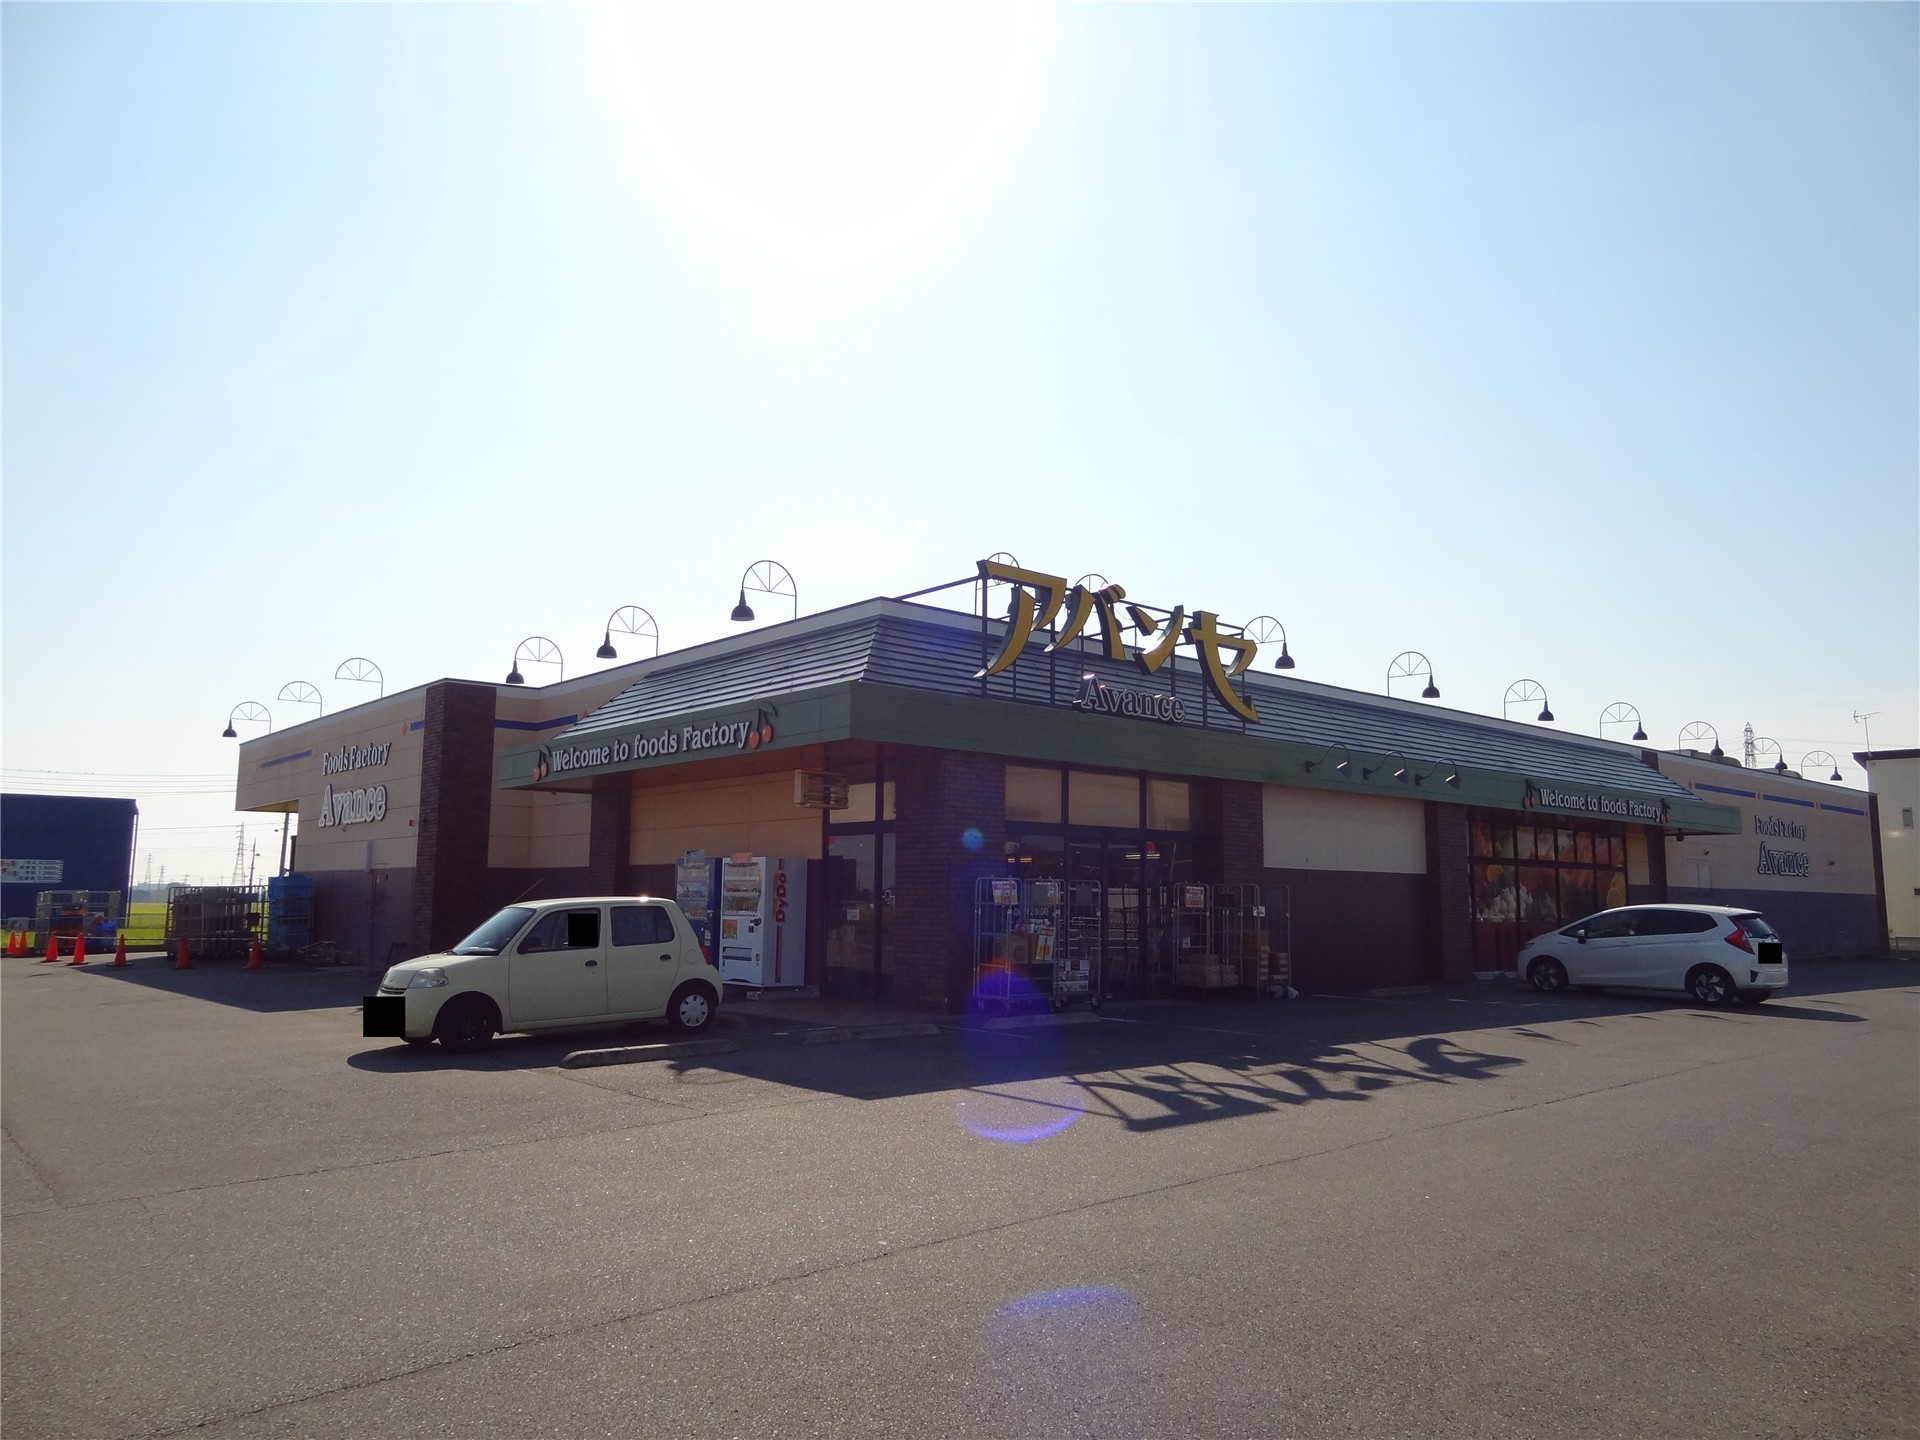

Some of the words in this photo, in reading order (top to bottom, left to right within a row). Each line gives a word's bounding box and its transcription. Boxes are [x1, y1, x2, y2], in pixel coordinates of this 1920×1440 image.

[973, 559, 1260, 723] アバンセ
[1075, 673, 1187, 723] Avance
[322, 746, 350, 776] Foods
[349, 742, 392, 771] Factory
[552, 744, 610, 772] Welcome
[613, 740, 629, 762] to
[633, 730, 679, 759] foods
[682, 720, 750, 752] Factory
[318, 783, 388, 828] Avance
[1539, 788, 1586, 810] Welcome
[1586, 794, 1598, 812] to
[1600, 796, 1627, 815] foods
[1629, 800, 1662, 823] Factory
[1754, 815, 1778, 836] Foods
[1778, 818, 1807, 841] Factory
[1758, 841, 1809, 878] Avance
[775, 872, 789, 924] DyDo
